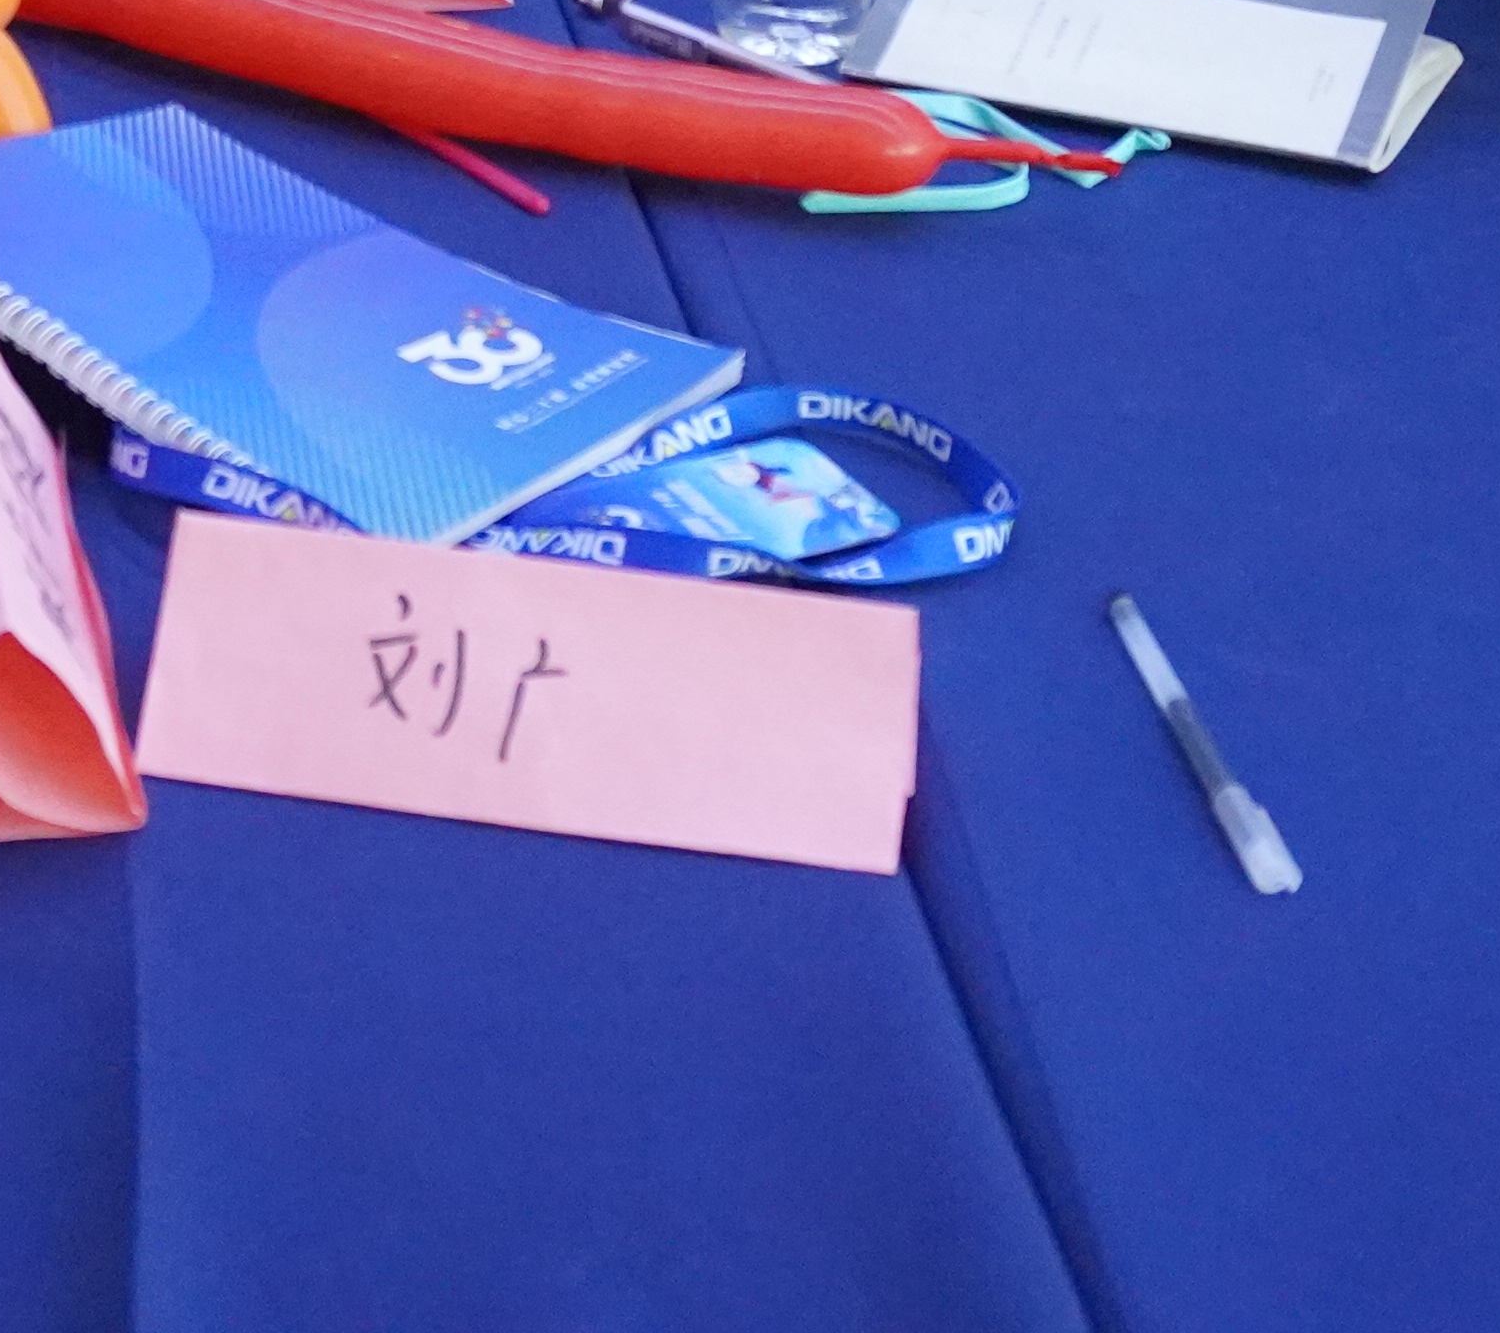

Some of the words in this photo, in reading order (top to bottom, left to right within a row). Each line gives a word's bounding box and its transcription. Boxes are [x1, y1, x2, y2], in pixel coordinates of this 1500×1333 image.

[590, 404, 733, 478] DIKANG
[799, 391, 953, 463] DIKANG
[368, 593, 568, 764] 刘广
